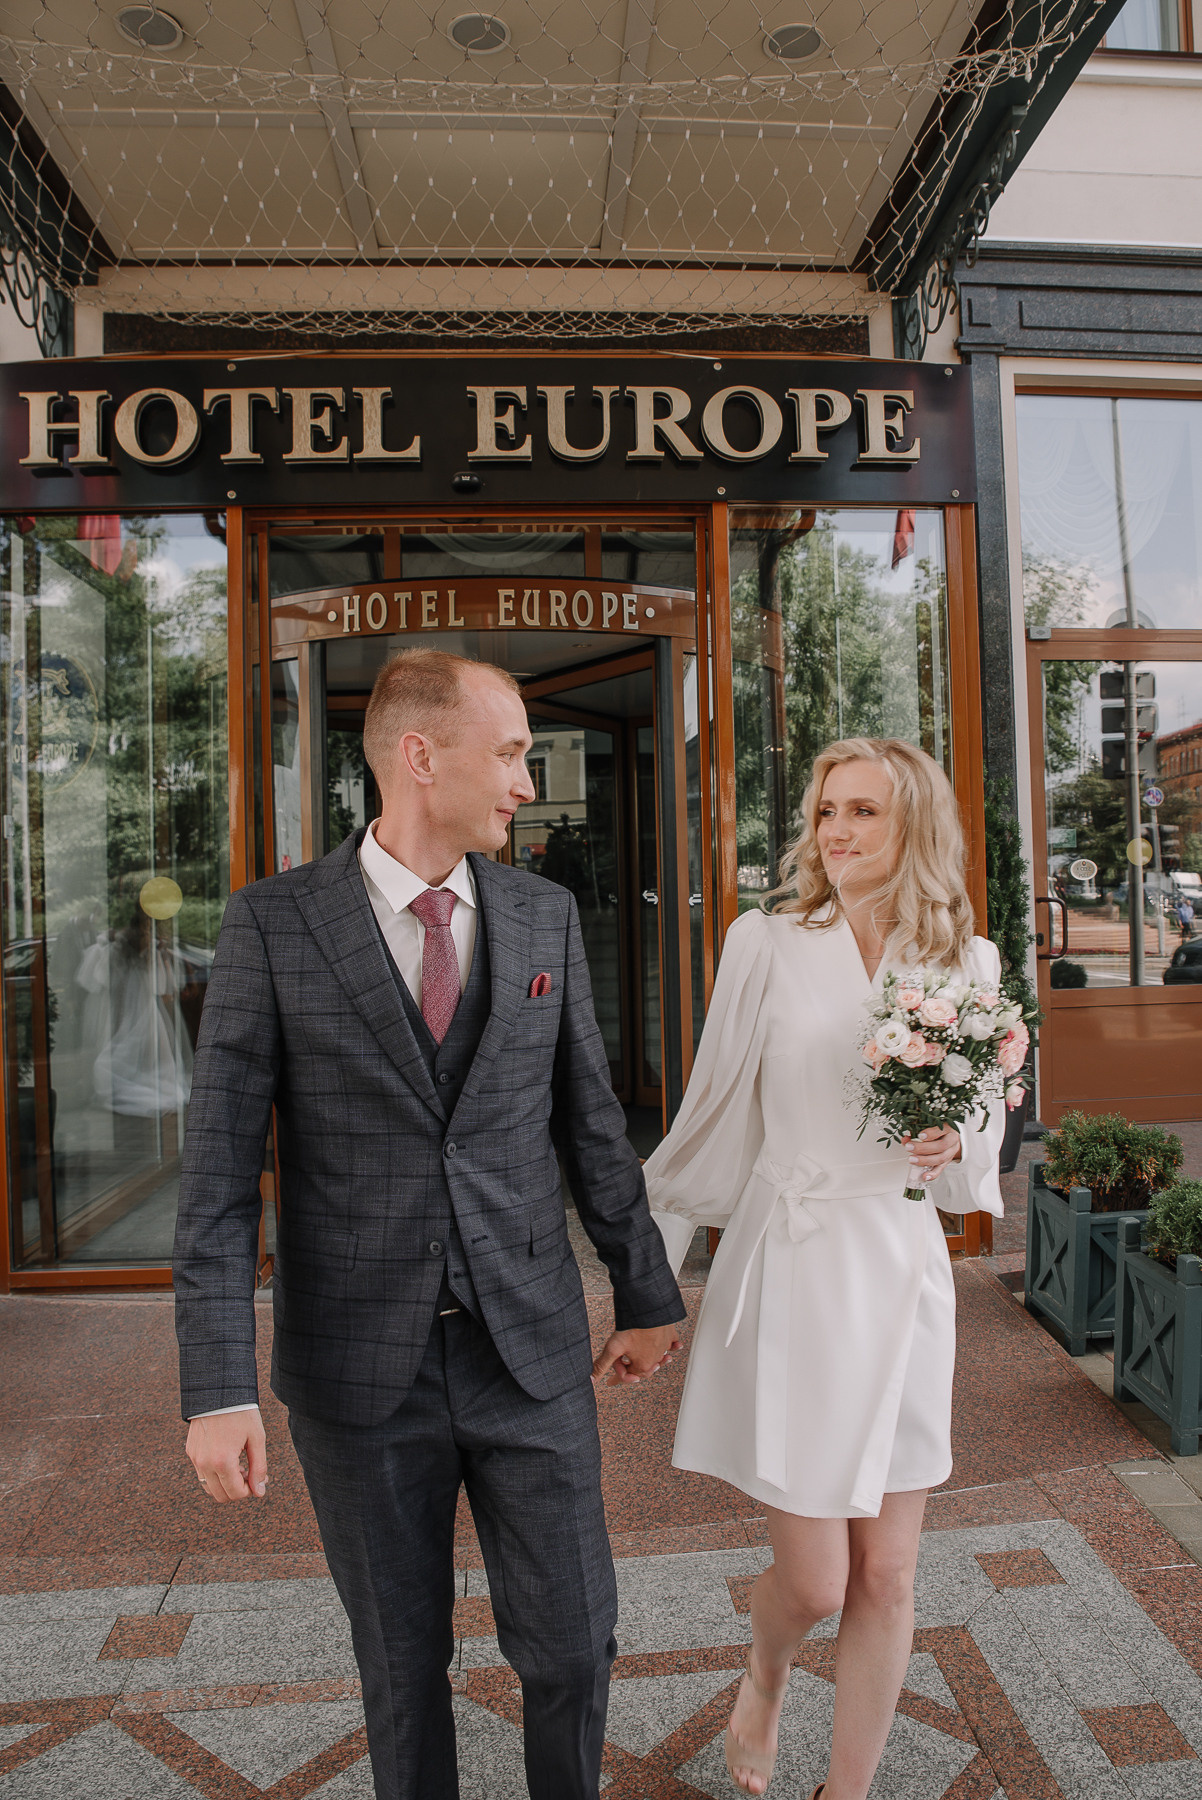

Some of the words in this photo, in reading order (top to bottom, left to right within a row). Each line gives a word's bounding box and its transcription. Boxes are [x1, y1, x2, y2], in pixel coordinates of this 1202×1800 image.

[18, 387, 422, 467] HOTEL
[466, 385, 922, 465] EUROPE
[342, 589, 465, 633] HOTEL
[497, 589, 639, 630] EUROPE
